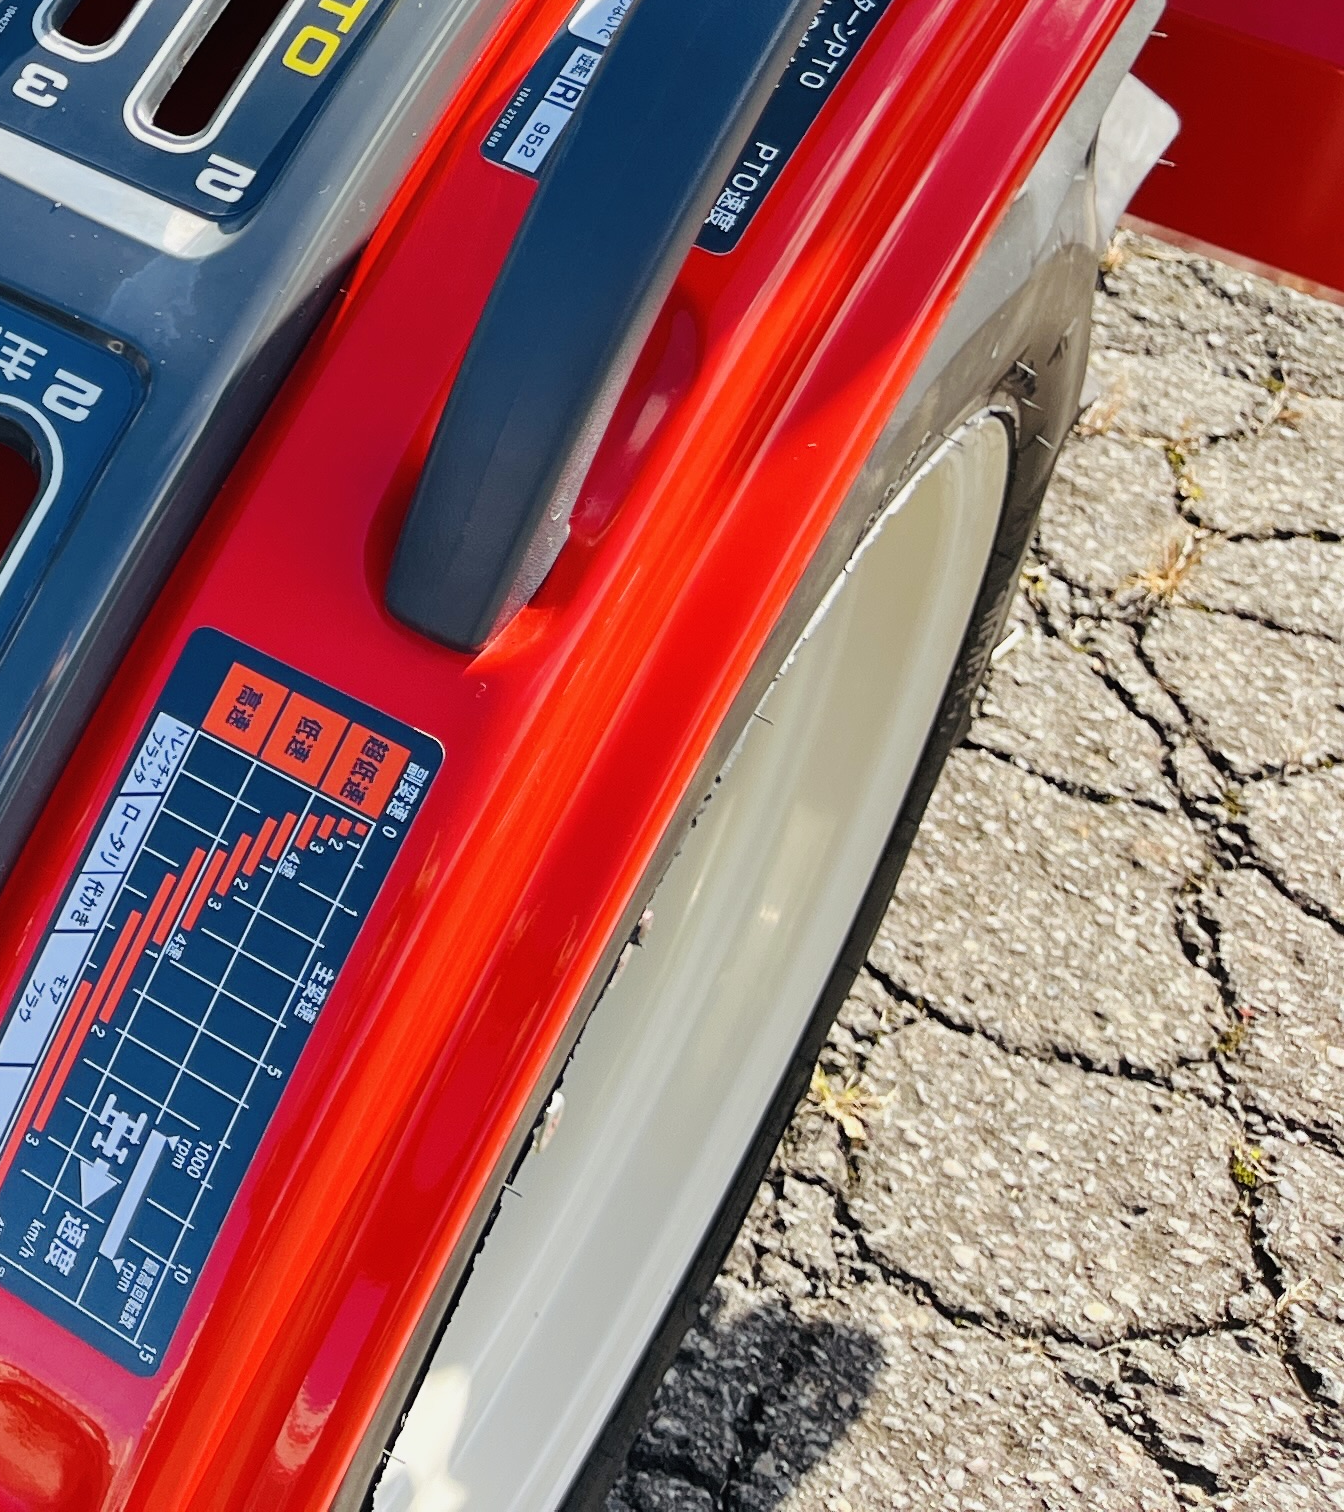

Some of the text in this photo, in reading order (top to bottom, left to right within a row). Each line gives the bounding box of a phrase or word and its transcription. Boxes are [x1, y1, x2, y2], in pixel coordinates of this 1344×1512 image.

[566, 51, 598, 81] 逆転
[12, 63, 68, 108] 3
[548, 79, 582, 104] R
[515, 118, 553, 161] 952
[195, 154, 256, 203] 2
[702, 141, 780, 233] PTO速度
[42, 368, 103, 422] 2
[223, 682, 265, 734] 高速
[282, 713, 324, 765] 低速
[147, 725, 190, 792] トレンチャ
[337, 733, 391, 807] 超低速
[384, 759, 429, 823] 副変速
[97, 802, 142, 869] ロータリ
[306, 840, 324, 855] 3
[325, 836, 344, 852] 2
[344, 837, 362, 851] 1
[379, 823, 397, 840] 0
[257, 861, 273, 874] 1
[276, 848, 303, 881] 4速
[232, 876, 249, 891] 2
[68, 876, 107, 930] 代かき
[205, 896, 222, 912] 3
[342, 904, 358, 918] 1
[143, 947, 158, 960] 1
[163, 930, 189, 962] 4速
[44, 971, 70, 1006] モア
[293, 960, 336, 1025] 主変速
[88, 1022, 106, 1040] 2
[264, 1062, 283, 1080] 5
[22, 1131, 40, 1148] 3
[167, 1135, 194, 1171] rpm
[183, 1137, 214, 1181] 1000
[14, 1215, 48, 1263] km/h
[40, 1208, 92, 1278] 速度
[113, 1259, 140, 1295] rpm
[171, 1260, 193, 1286] 10
[116, 1255, 161, 1332] 最高回転数
[136, 1340, 158, 1366] 15
